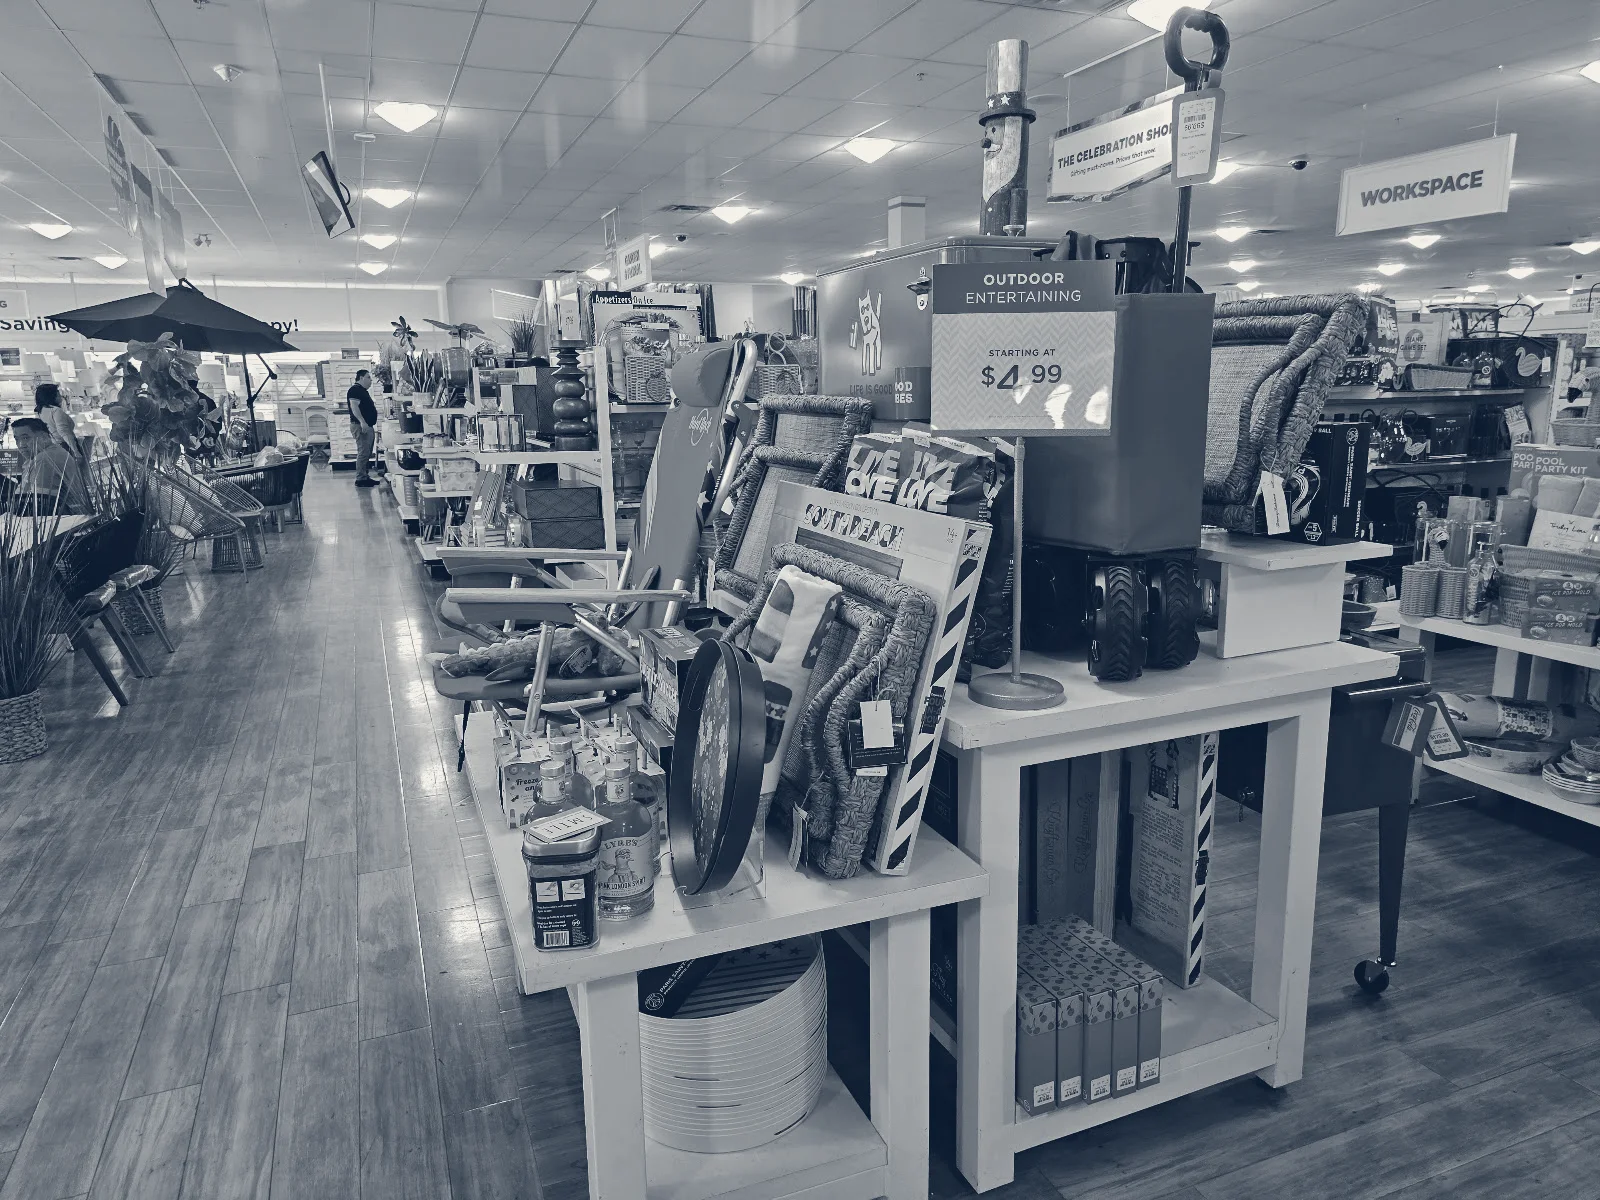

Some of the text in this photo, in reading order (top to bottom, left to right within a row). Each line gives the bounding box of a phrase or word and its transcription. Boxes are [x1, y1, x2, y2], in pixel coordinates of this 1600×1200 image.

[1058, 154, 1075, 169] THE
[1076, 132, 1144, 164] CELEBRATION
[1360, 169, 1484, 207] WORKSPACE
[983, 272, 1065, 286] OUTDOOR
[595, 294, 632, 304] Appetizers
[966, 290, 1081, 304] ENTERTAINING
[988, 348, 1056, 357] STARTING AT
[874, 383, 893, 395] GOOD
[1513, 453, 1534, 461] POO
[1535, 457, 1565, 466] POOL
[1512, 460, 1535, 469] PART
[1534, 465, 1588, 475] PARTY KIT
